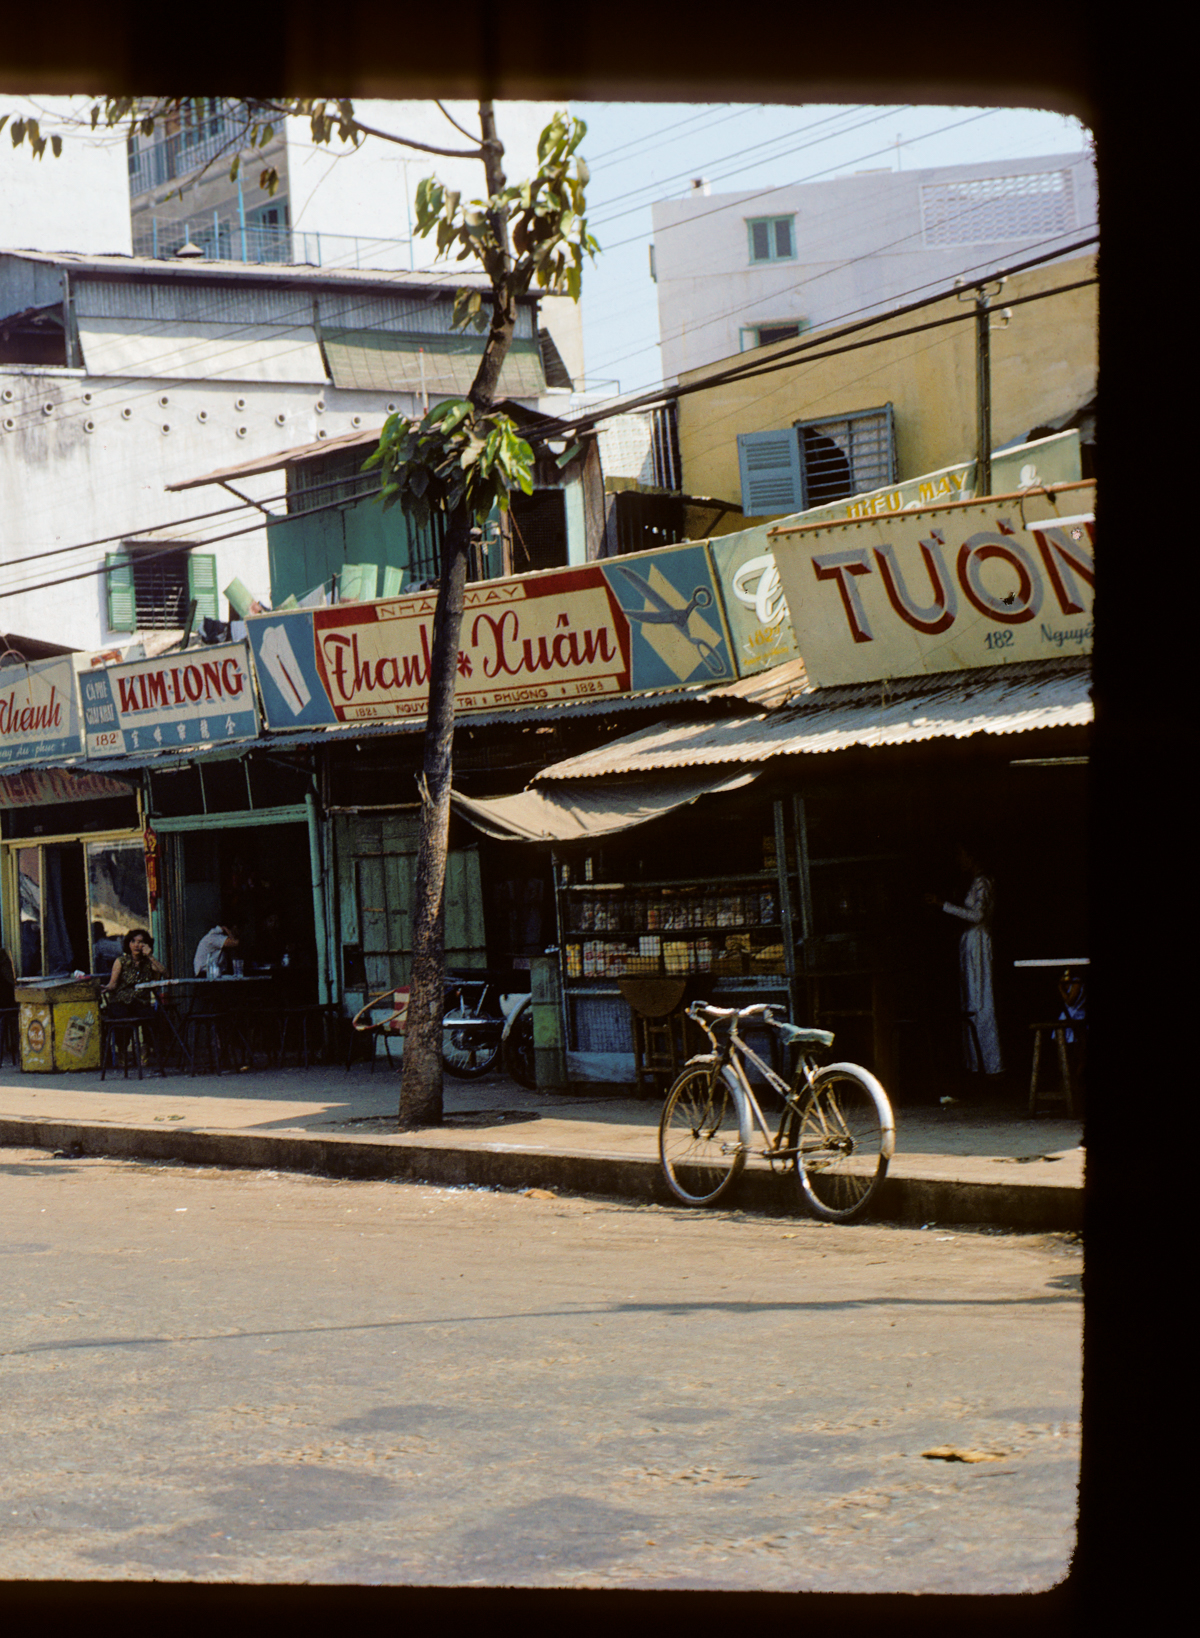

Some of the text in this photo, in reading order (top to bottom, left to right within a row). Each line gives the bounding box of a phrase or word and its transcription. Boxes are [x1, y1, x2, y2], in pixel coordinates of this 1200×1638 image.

[918, 470, 968, 503] MAY
[471, 609, 617, 679] Xuân
[984, 629, 1015, 650] 182
[396, 701, 429, 716] NGUY
